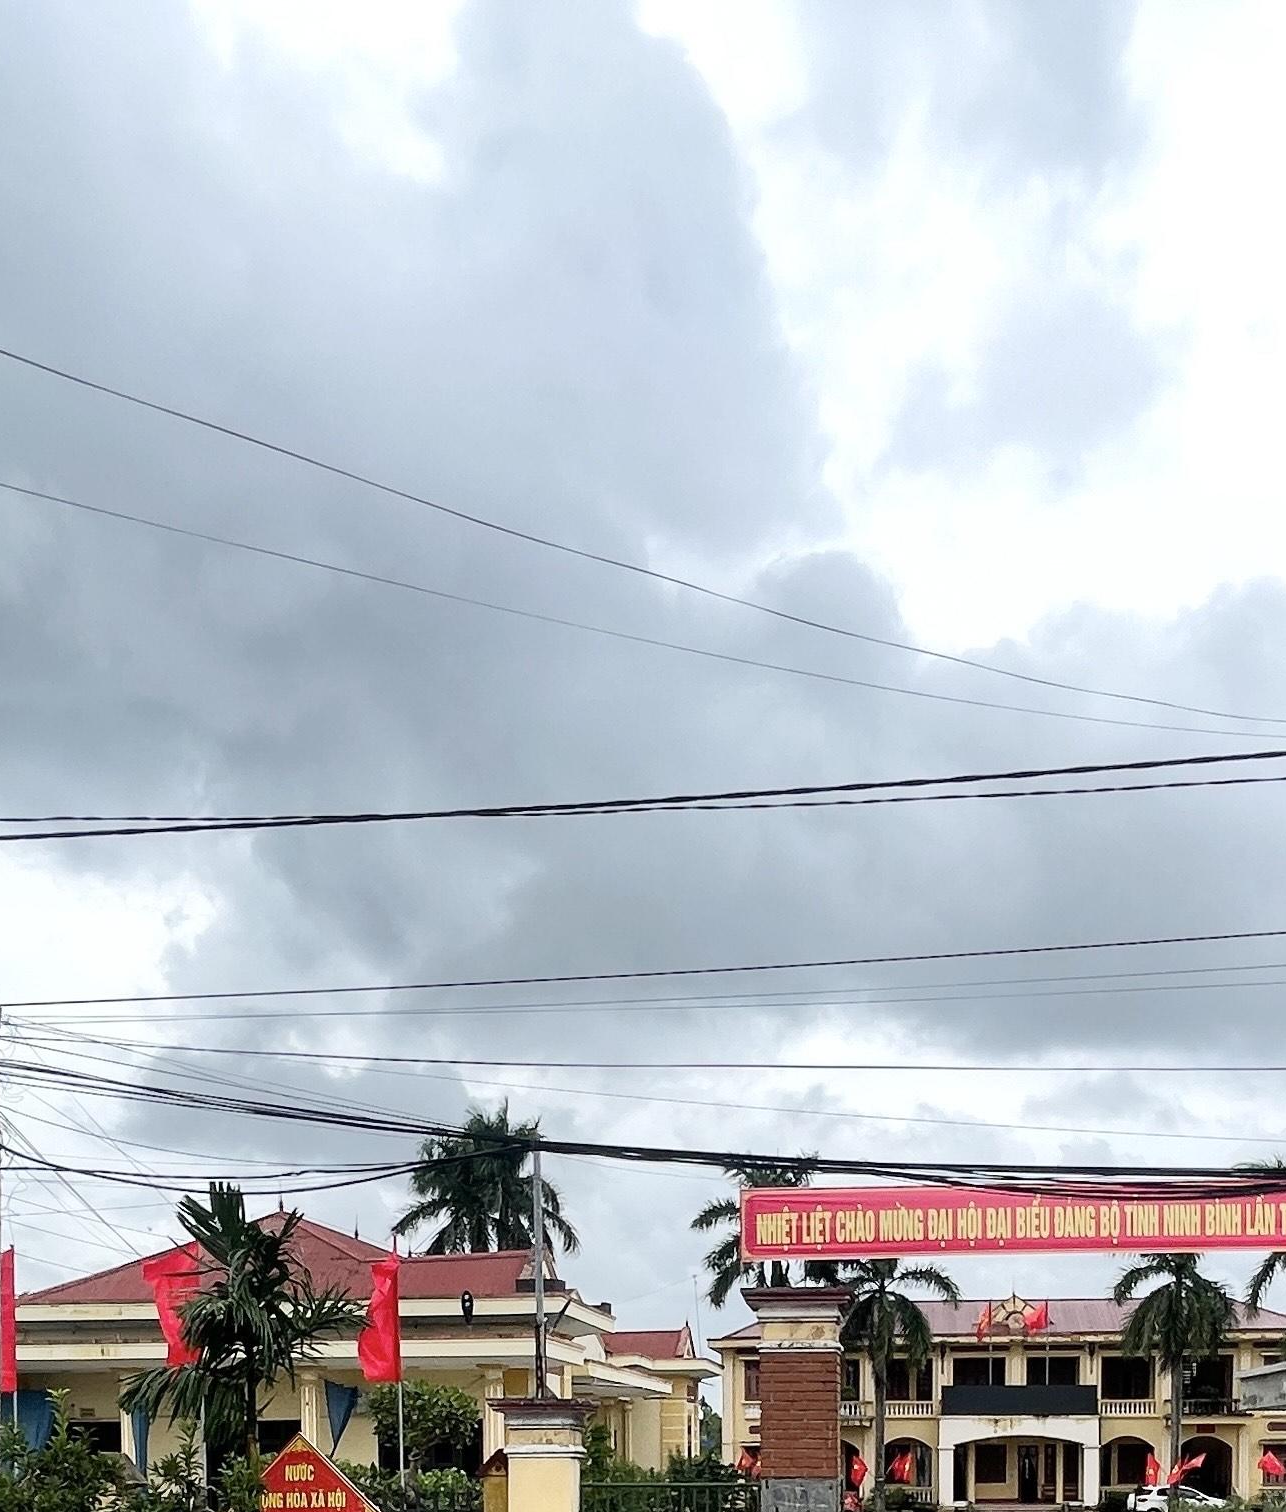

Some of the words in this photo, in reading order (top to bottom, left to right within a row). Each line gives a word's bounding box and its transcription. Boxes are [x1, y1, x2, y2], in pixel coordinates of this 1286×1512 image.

[756, 1205, 798, 1251] NHIỆT
[802, 1204, 833, 1250] LIỆT
[835, 1203, 876, 1243] CHÀO
[879, 1201, 924, 1241] MỪNG
[927, 1207, 953, 1247] ĐẠI
[957, 1201, 982, 1246] HỘI
[986, 1206, 1012, 1246] ĐẠI
[1016, 1194, 1050, 1239] BIỂU
[1054, 1197, 1096, 1239] ĐẢNG
[1099, 1199, 1120, 1244] BỘ
[1163, 1203, 1201, 1238] NINH
[1204, 1198, 1242, 1236] BÌNH
[1245, 1195, 1276, 1236] LẦN
[285, 1462, 315, 1482] NƯỚC
[261, 1489, 284, 1511] ỘNG
[286, 1487, 308, 1508] HÒA
[310, 1488, 326, 1508] XÃ
[328, 1487, 347, 1511] HỘI
